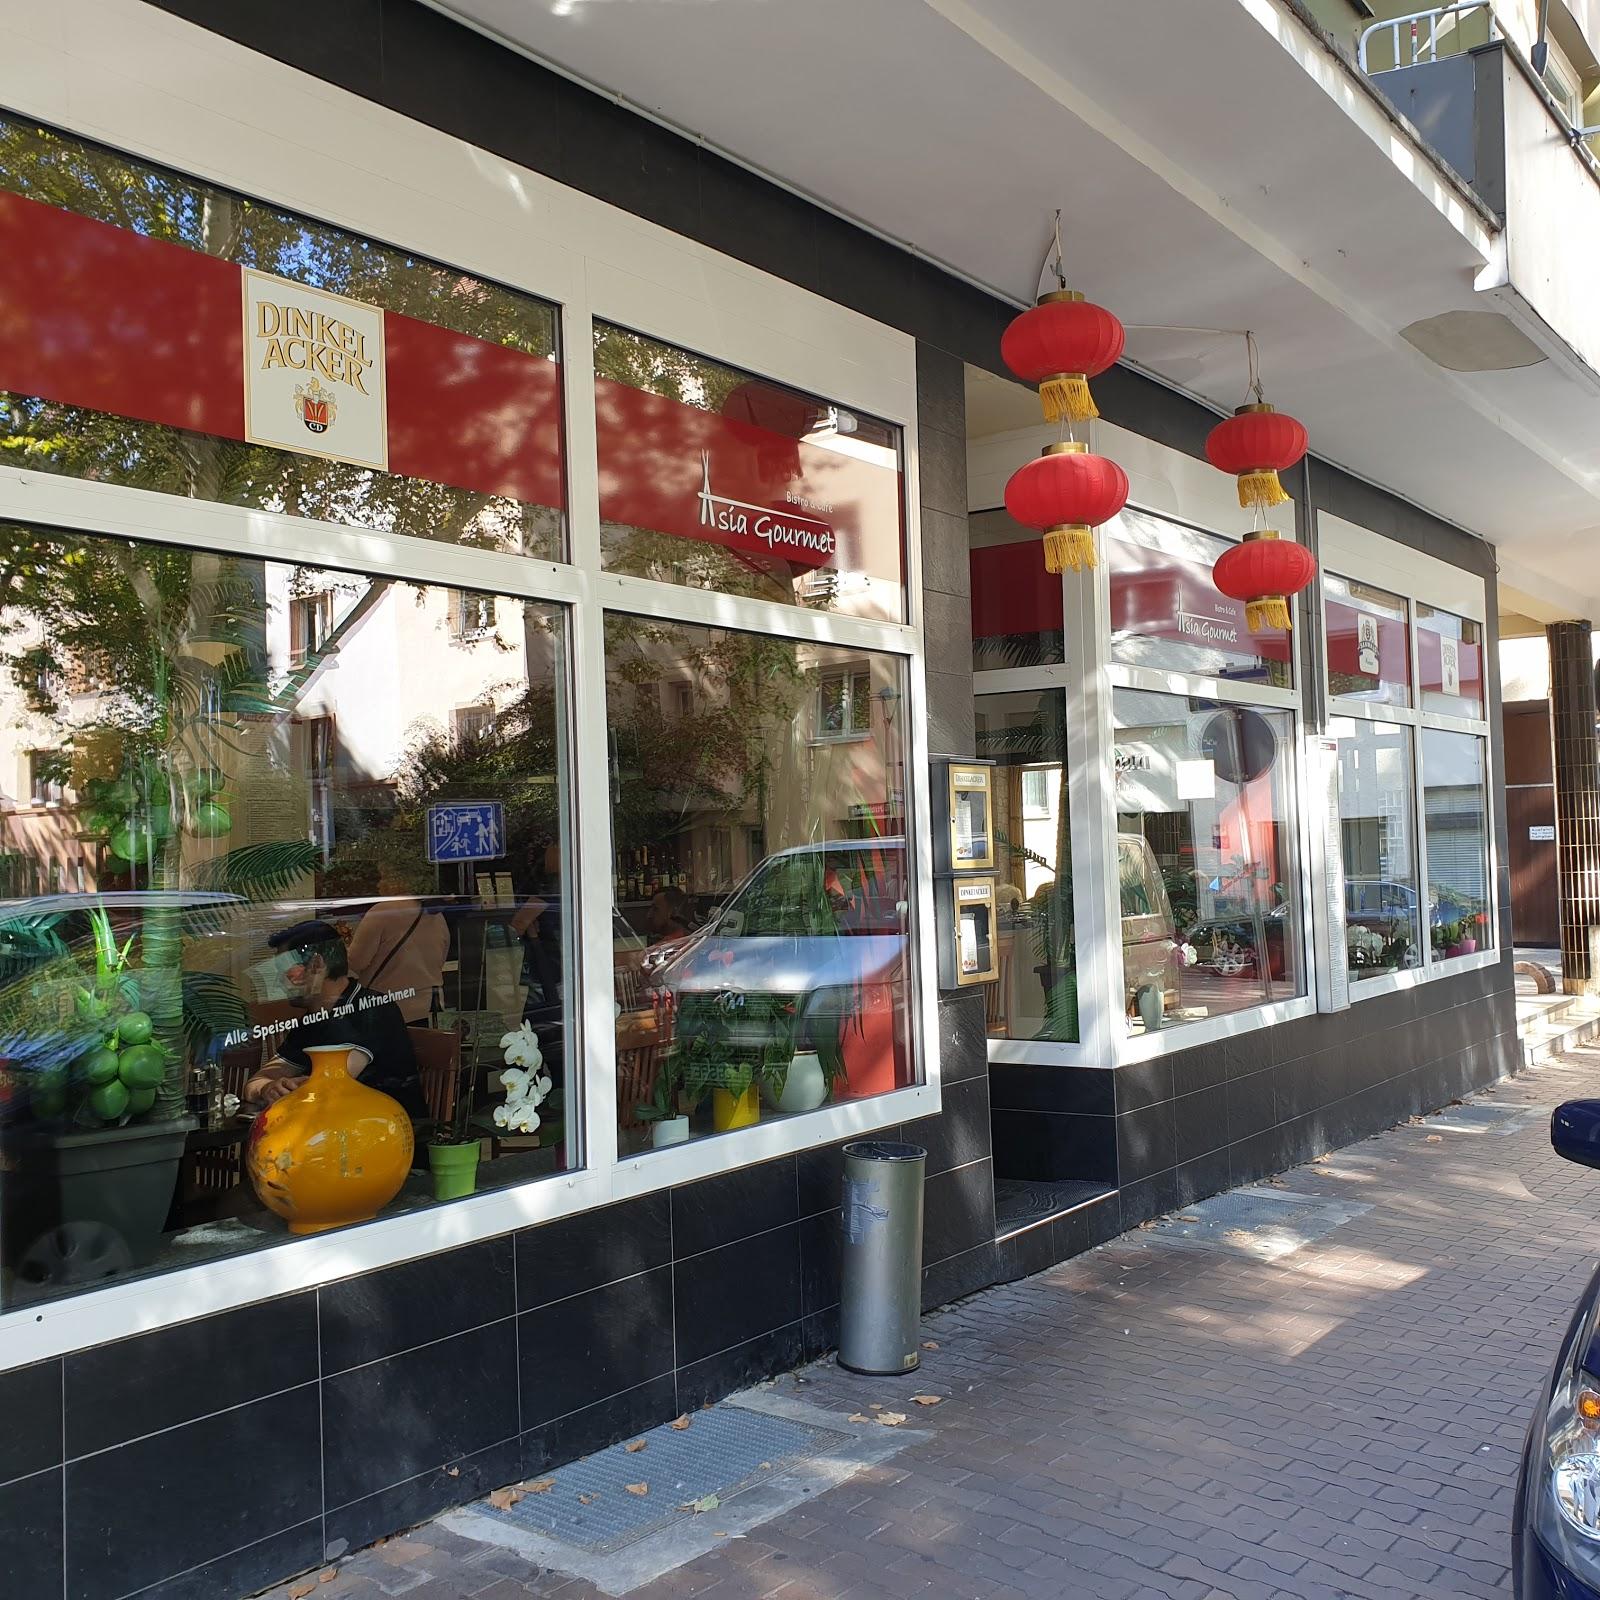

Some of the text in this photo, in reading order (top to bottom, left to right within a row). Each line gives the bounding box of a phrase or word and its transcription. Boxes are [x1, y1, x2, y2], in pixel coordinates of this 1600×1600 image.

[256, 301, 373, 368] DINKEL
[261, 338, 369, 396] ACKER
[308, 421, 323, 432] CD
[697, 447, 835, 554] Asia Gourmet
[786, 490, 809, 508] Bistro
[1201, 621, 1238, 643] Gourmet
[224, 986, 416, 1048] Alle Speisen auch zum Mitnehmen
